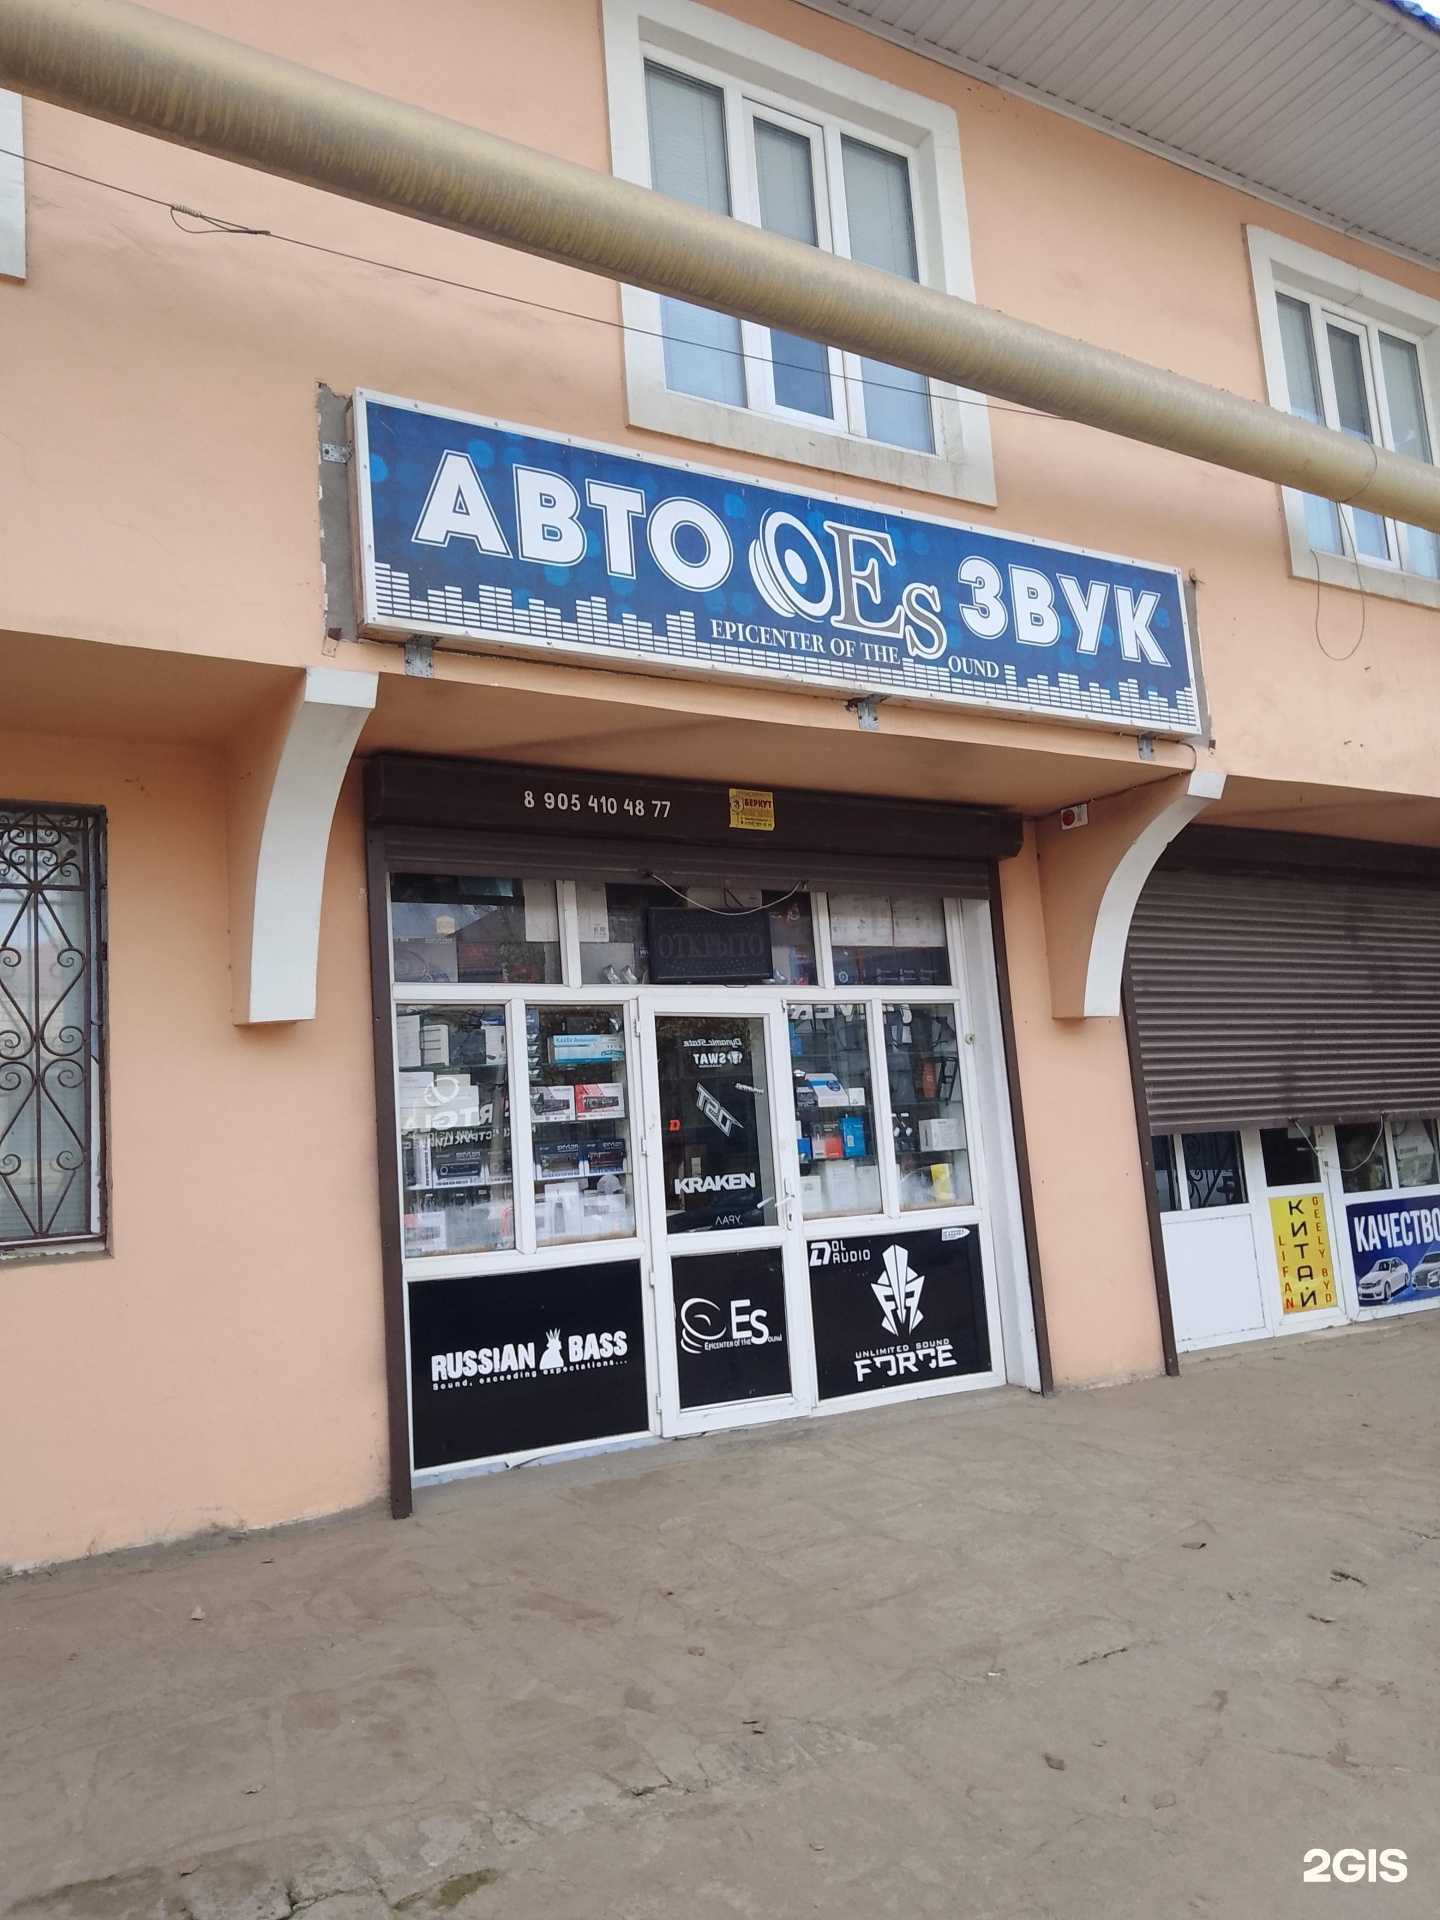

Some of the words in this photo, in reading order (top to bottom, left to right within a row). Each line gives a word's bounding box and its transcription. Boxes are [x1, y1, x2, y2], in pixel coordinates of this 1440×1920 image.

[411, 449, 734, 593] АВТО
[957, 555, 1172, 668] ЗВУК
[710, 619, 826, 655] EPICENTER
[830, 637, 856, 658] OF
[860, 641, 902, 665] THE
[524, 790, 535, 808] 8
[543, 792, 581, 811] 905
[587, 794, 618, 815] 410
[623, 798, 645, 817] 48
[651, 800, 671, 818] 77
[674, 1172, 756, 1195] KRAKEN
[1288, 1199, 1318, 1307] КИТАЙ
[1312, 1196, 1326, 1258] GEELY
[1322, 1267, 1332, 1303] BYD
[1353, 1207, 1440, 1253] КАЧЕСТВО
[832, 1249, 871, 1265] AUDIO
[1278, 1235, 1294, 1309] LIFAN
[431, 1342, 536, 1382] RUSSIAN
[568, 1330, 628, 1363] BASS
[853, 1344, 958, 1382] FORCE
[855, 1344, 910, 1359] UNLIMITED
[916, 1338, 950, 1349] SOUND
[479, 1370, 537, 1385] exceeding
